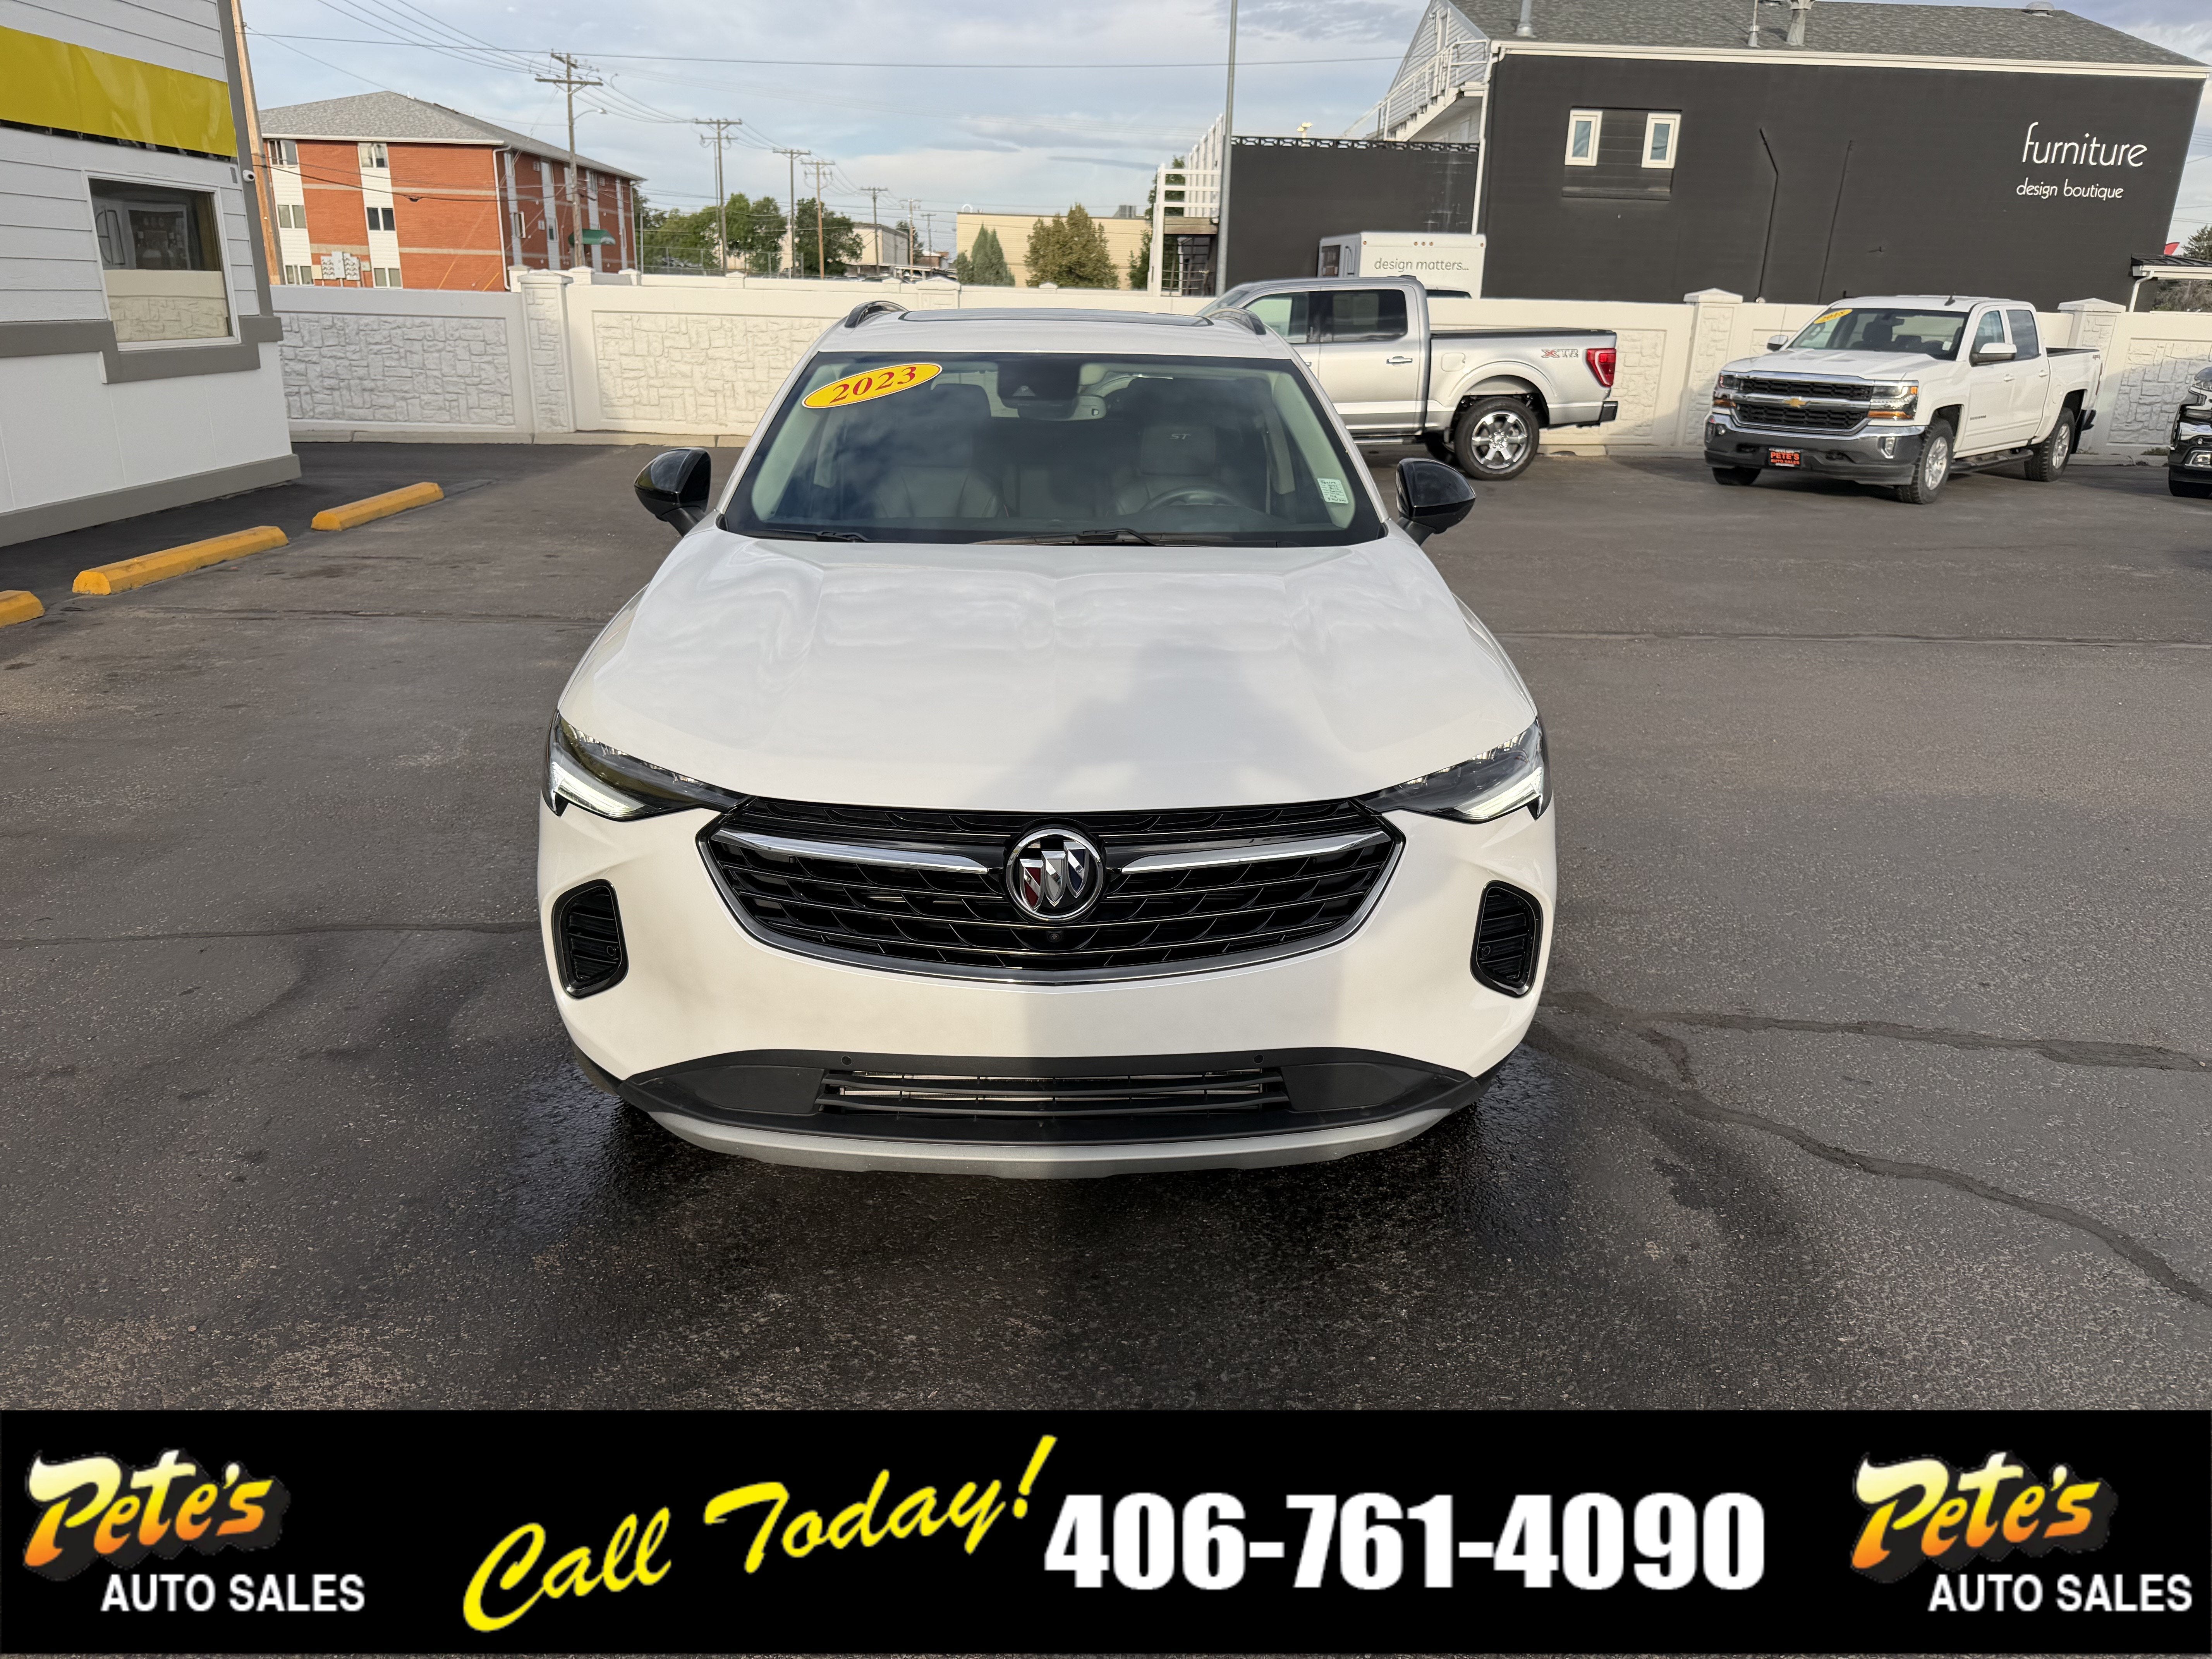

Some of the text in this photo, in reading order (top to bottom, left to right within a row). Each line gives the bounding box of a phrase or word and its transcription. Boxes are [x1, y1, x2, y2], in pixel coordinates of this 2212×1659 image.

[2022, 122, 2148, 167] furniture
[2016, 177, 2124, 201] design boutique
[1374, 257, 1470, 273] design matters...
[829, 366, 917, 404] 2023
[1771, 452, 1800, 460] PETE'S
